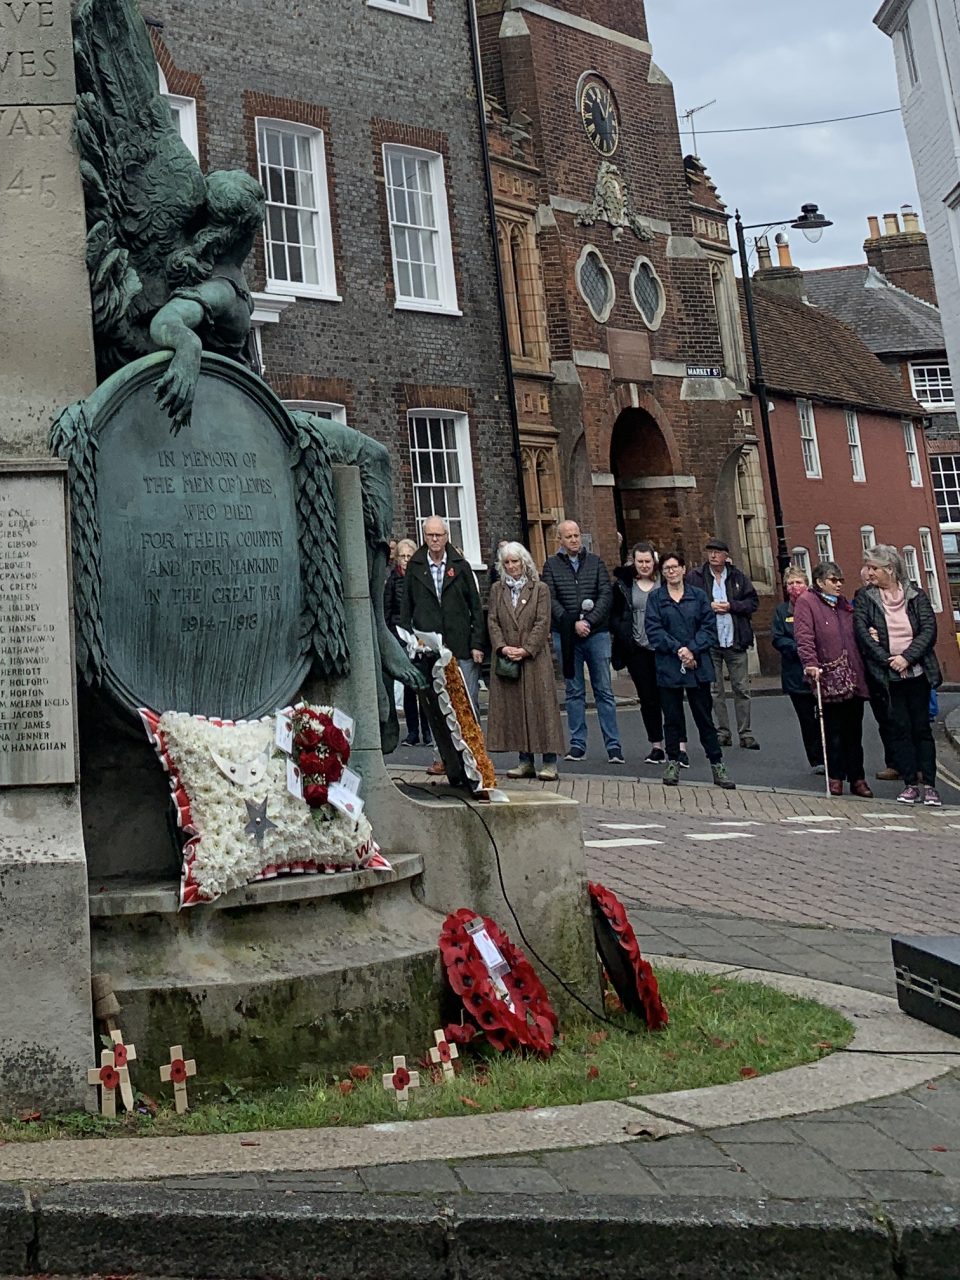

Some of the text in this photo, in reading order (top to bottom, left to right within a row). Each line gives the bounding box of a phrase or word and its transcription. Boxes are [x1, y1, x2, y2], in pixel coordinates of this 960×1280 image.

[687, 368, 711, 376] MARKET
[158, 450, 257, 468] IN MEMORY OF
[142, 475, 176, 494] THE
[182, 476, 215, 493] MEN
[218, 476, 235, 493] OF
[183, 504, 253, 521] WHO DIED
[7, 540, 38, 549] GIBSON
[140, 530, 284, 549] FOR THEIR COUNTRY
[147, 557, 279, 578] AND FOR MANKIND
[144, 584, 281, 606] IN THE GREAT WAR
[1, 646, 45, 655] HATHAWAY
[0, 667, 42, 677] HERRIOTT
[9, 689, 45, 698] HORTON
[12, 710, 44, 720] JACOBS
[22, 721, 52, 729] JAMES
[16, 732, 50, 741] JENNER
[11, 742, 67, 752] HANAGHAN
